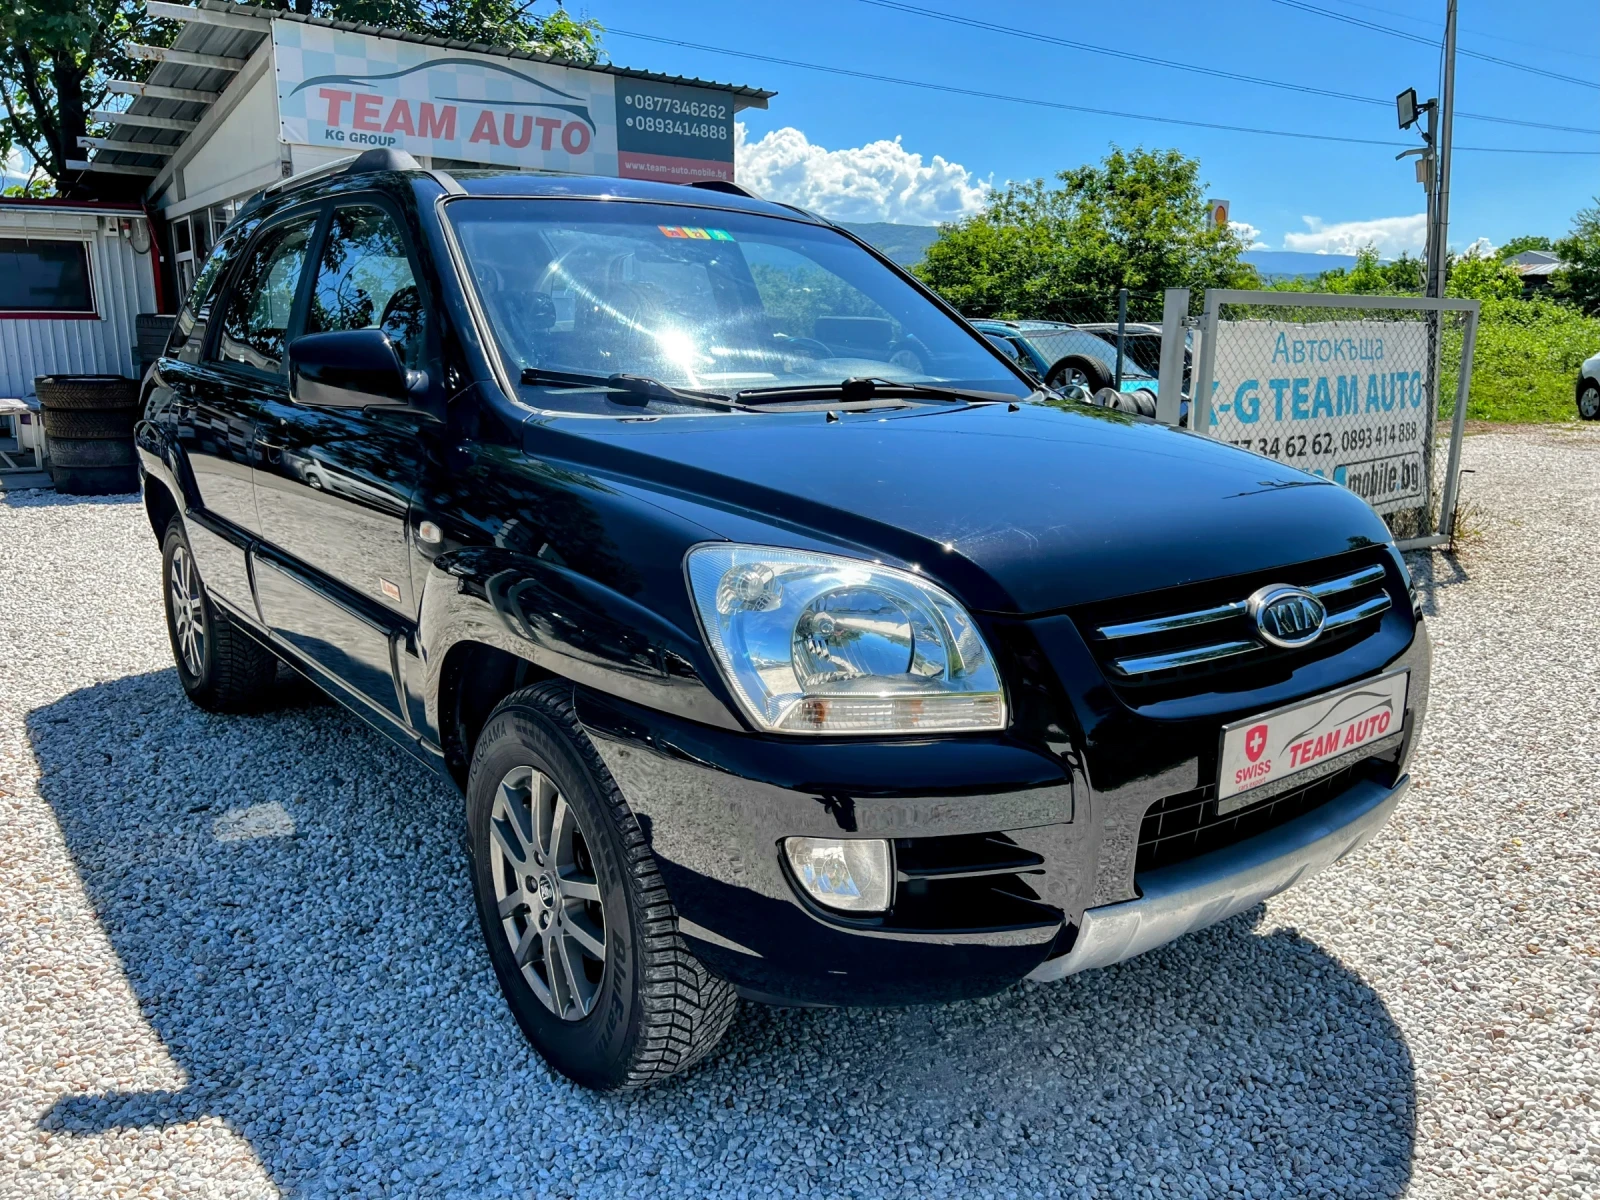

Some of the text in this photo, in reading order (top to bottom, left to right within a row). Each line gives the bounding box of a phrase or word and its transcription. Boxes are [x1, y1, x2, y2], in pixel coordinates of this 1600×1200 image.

[319, 88, 591, 155] TEAM AUTO
[634, 94, 726, 119] 0877346262
[325, 129, 396, 147] KG GROUP
[635, 116, 727, 140] 0893414888
[625, 161, 727, 180] www.team-auto.mobile.bg
[1271, 331, 1384, 364] Автокъща
[1269, 375, 1358, 421] TEAM
[1365, 370, 1422, 413] AUTO
[1258, 437, 1280, 459] 34
[1285, 434, 1307, 458] 62
[1312, 432, 1337, 457] 62,
[1341, 430, 1372, 452] 0893
[1375, 424, 1396, 447] 414
[1398, 421, 1417, 443] 888
[1348, 459, 1419, 499] mobile.bg
[1271, 599, 1320, 636] KIA
[1289, 711, 1391, 768] TEAM AUTO
[1235, 759, 1272, 784] SWISS
